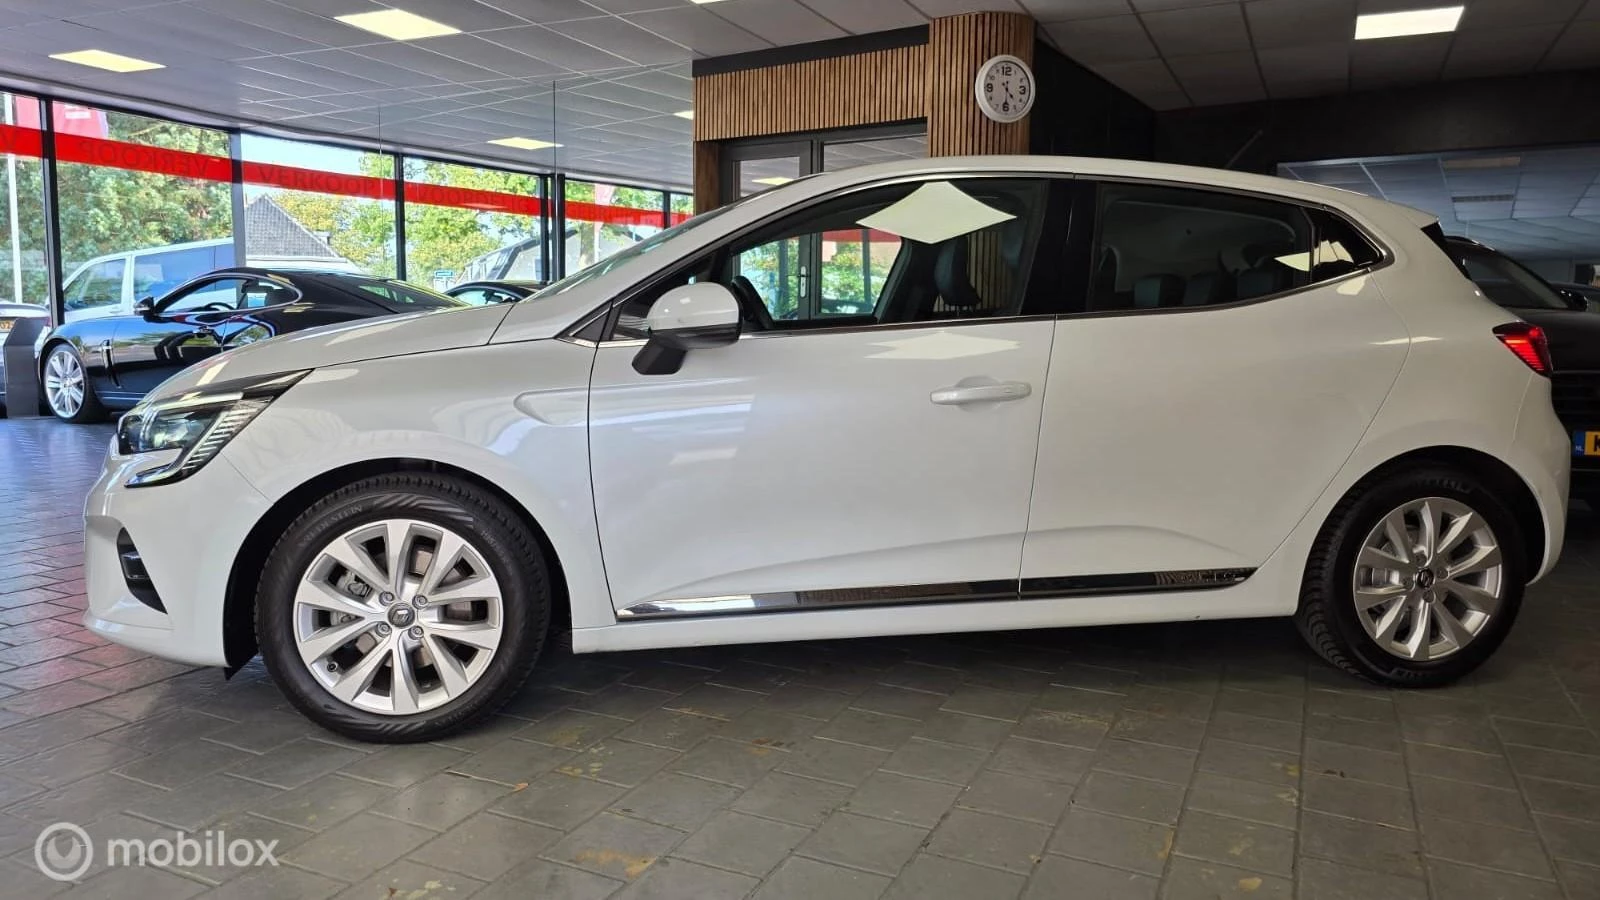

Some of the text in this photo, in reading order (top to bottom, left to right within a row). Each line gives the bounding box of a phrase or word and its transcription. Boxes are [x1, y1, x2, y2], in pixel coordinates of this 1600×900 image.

[1001, 66, 1012, 76] 12
[986, 83, 993, 92] 9
[1019, 86, 1026, 95] 3
[1002, 102, 1010, 112] 6
[257, 165, 377, 197] VERKOOP
